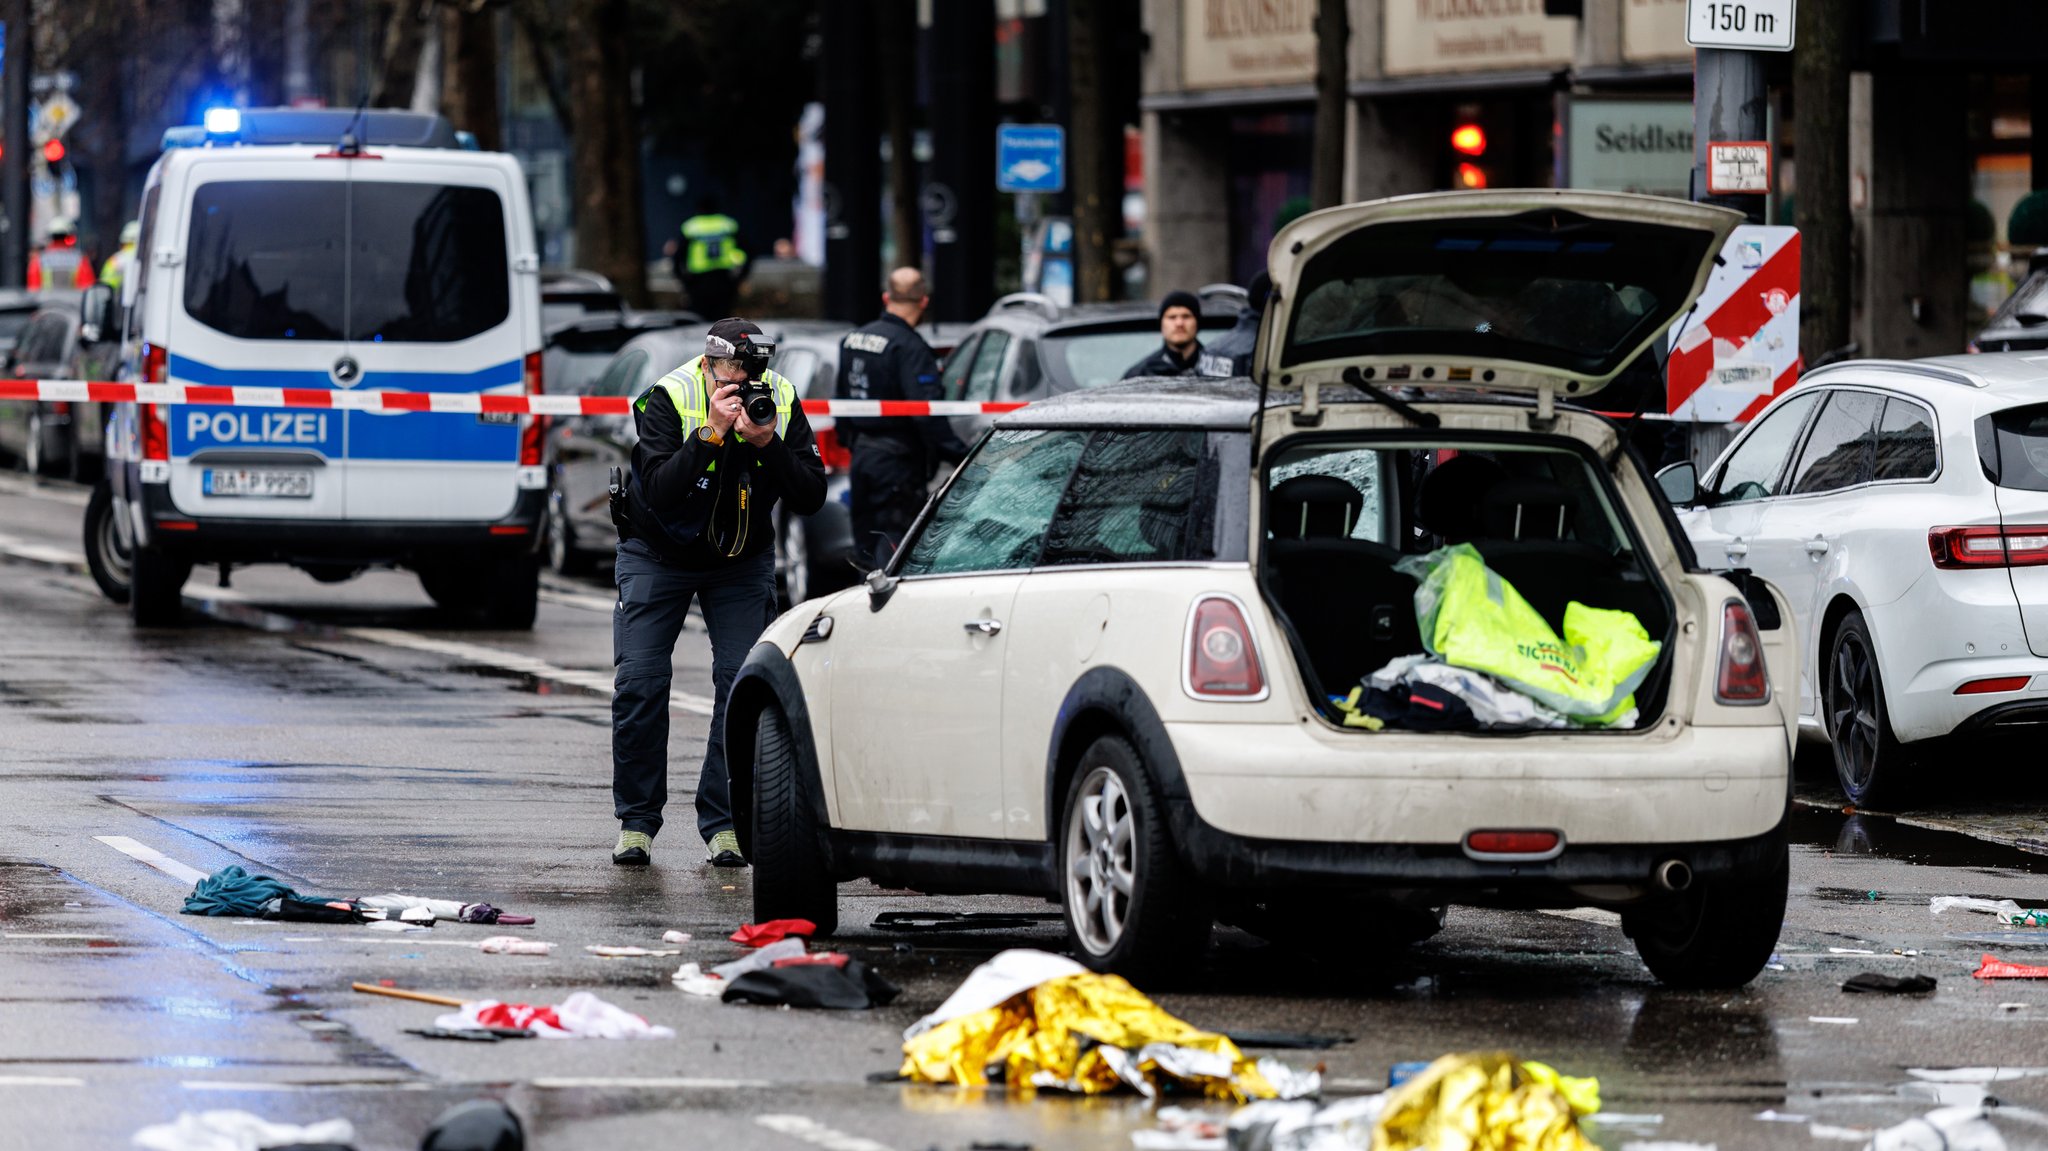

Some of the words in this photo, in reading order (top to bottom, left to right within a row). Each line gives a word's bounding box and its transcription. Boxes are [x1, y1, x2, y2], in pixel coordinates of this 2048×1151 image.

[1708, 4, 1746, 31] 150
[1755, 14, 1774, 33] m
[1733, 147, 1756, 161] 200
[843, 332, 889, 354] POLIZEI
[187, 412, 327, 442] POLIZEI
